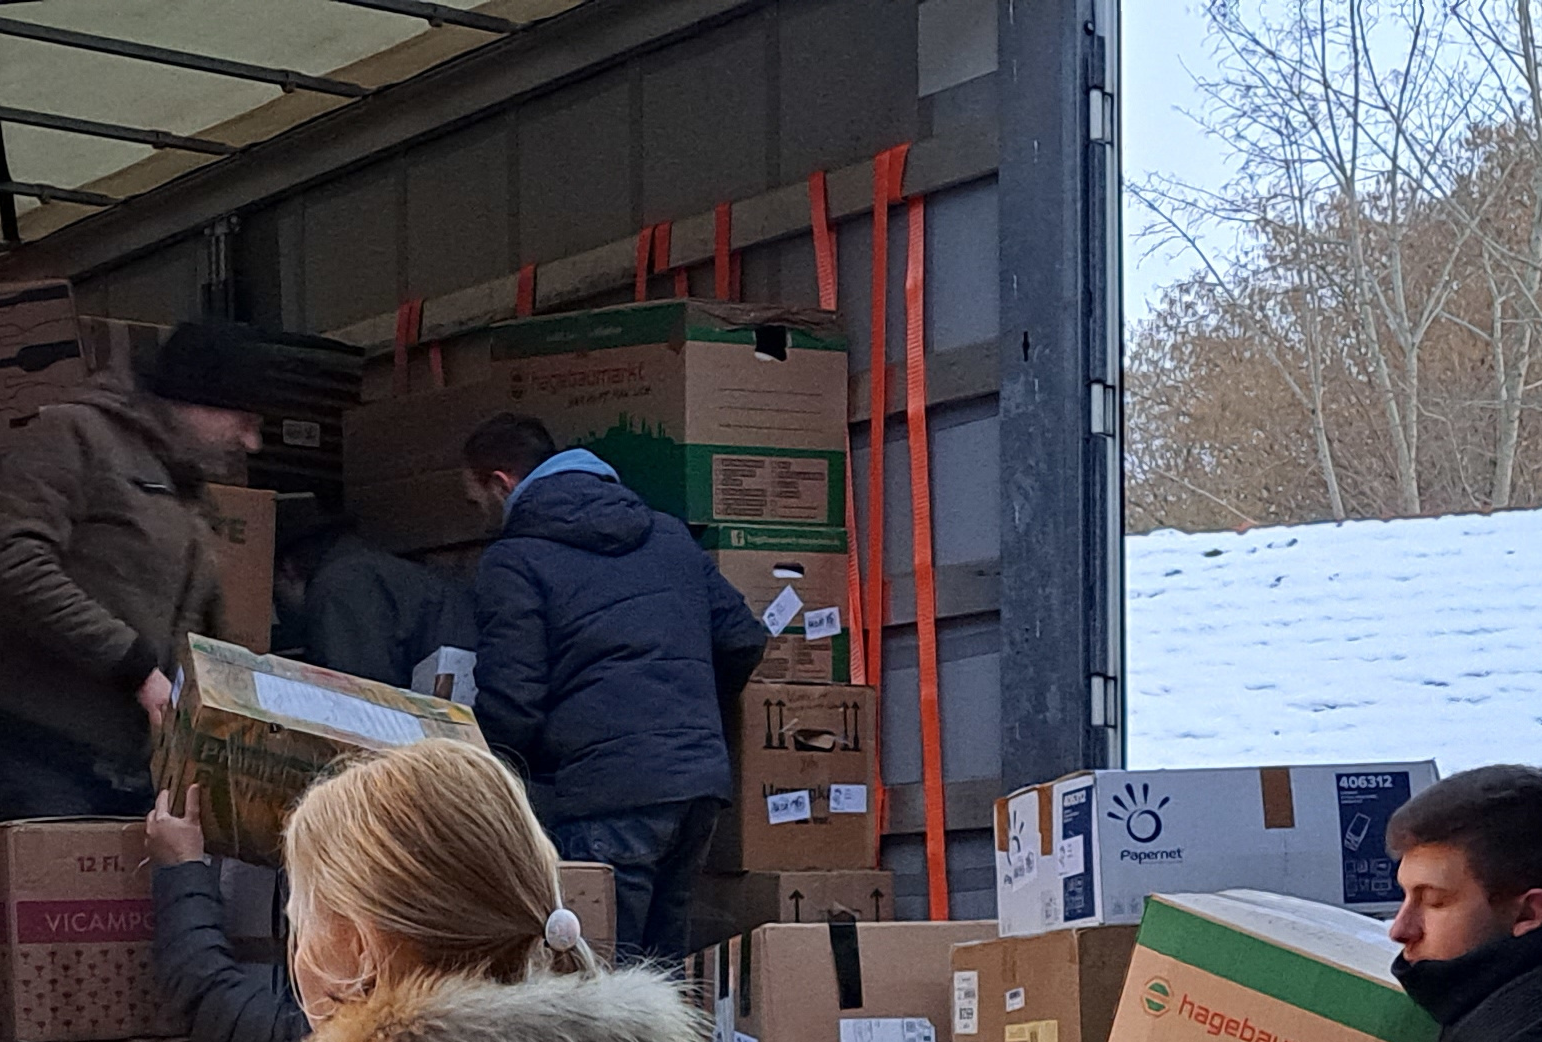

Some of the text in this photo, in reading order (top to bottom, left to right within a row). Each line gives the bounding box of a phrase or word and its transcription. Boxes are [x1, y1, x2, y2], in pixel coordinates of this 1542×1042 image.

[1339, 775, 1393, 788] 406312
[1120, 848, 1183, 864] Papernet
[77, 857, 97, 873] 12
